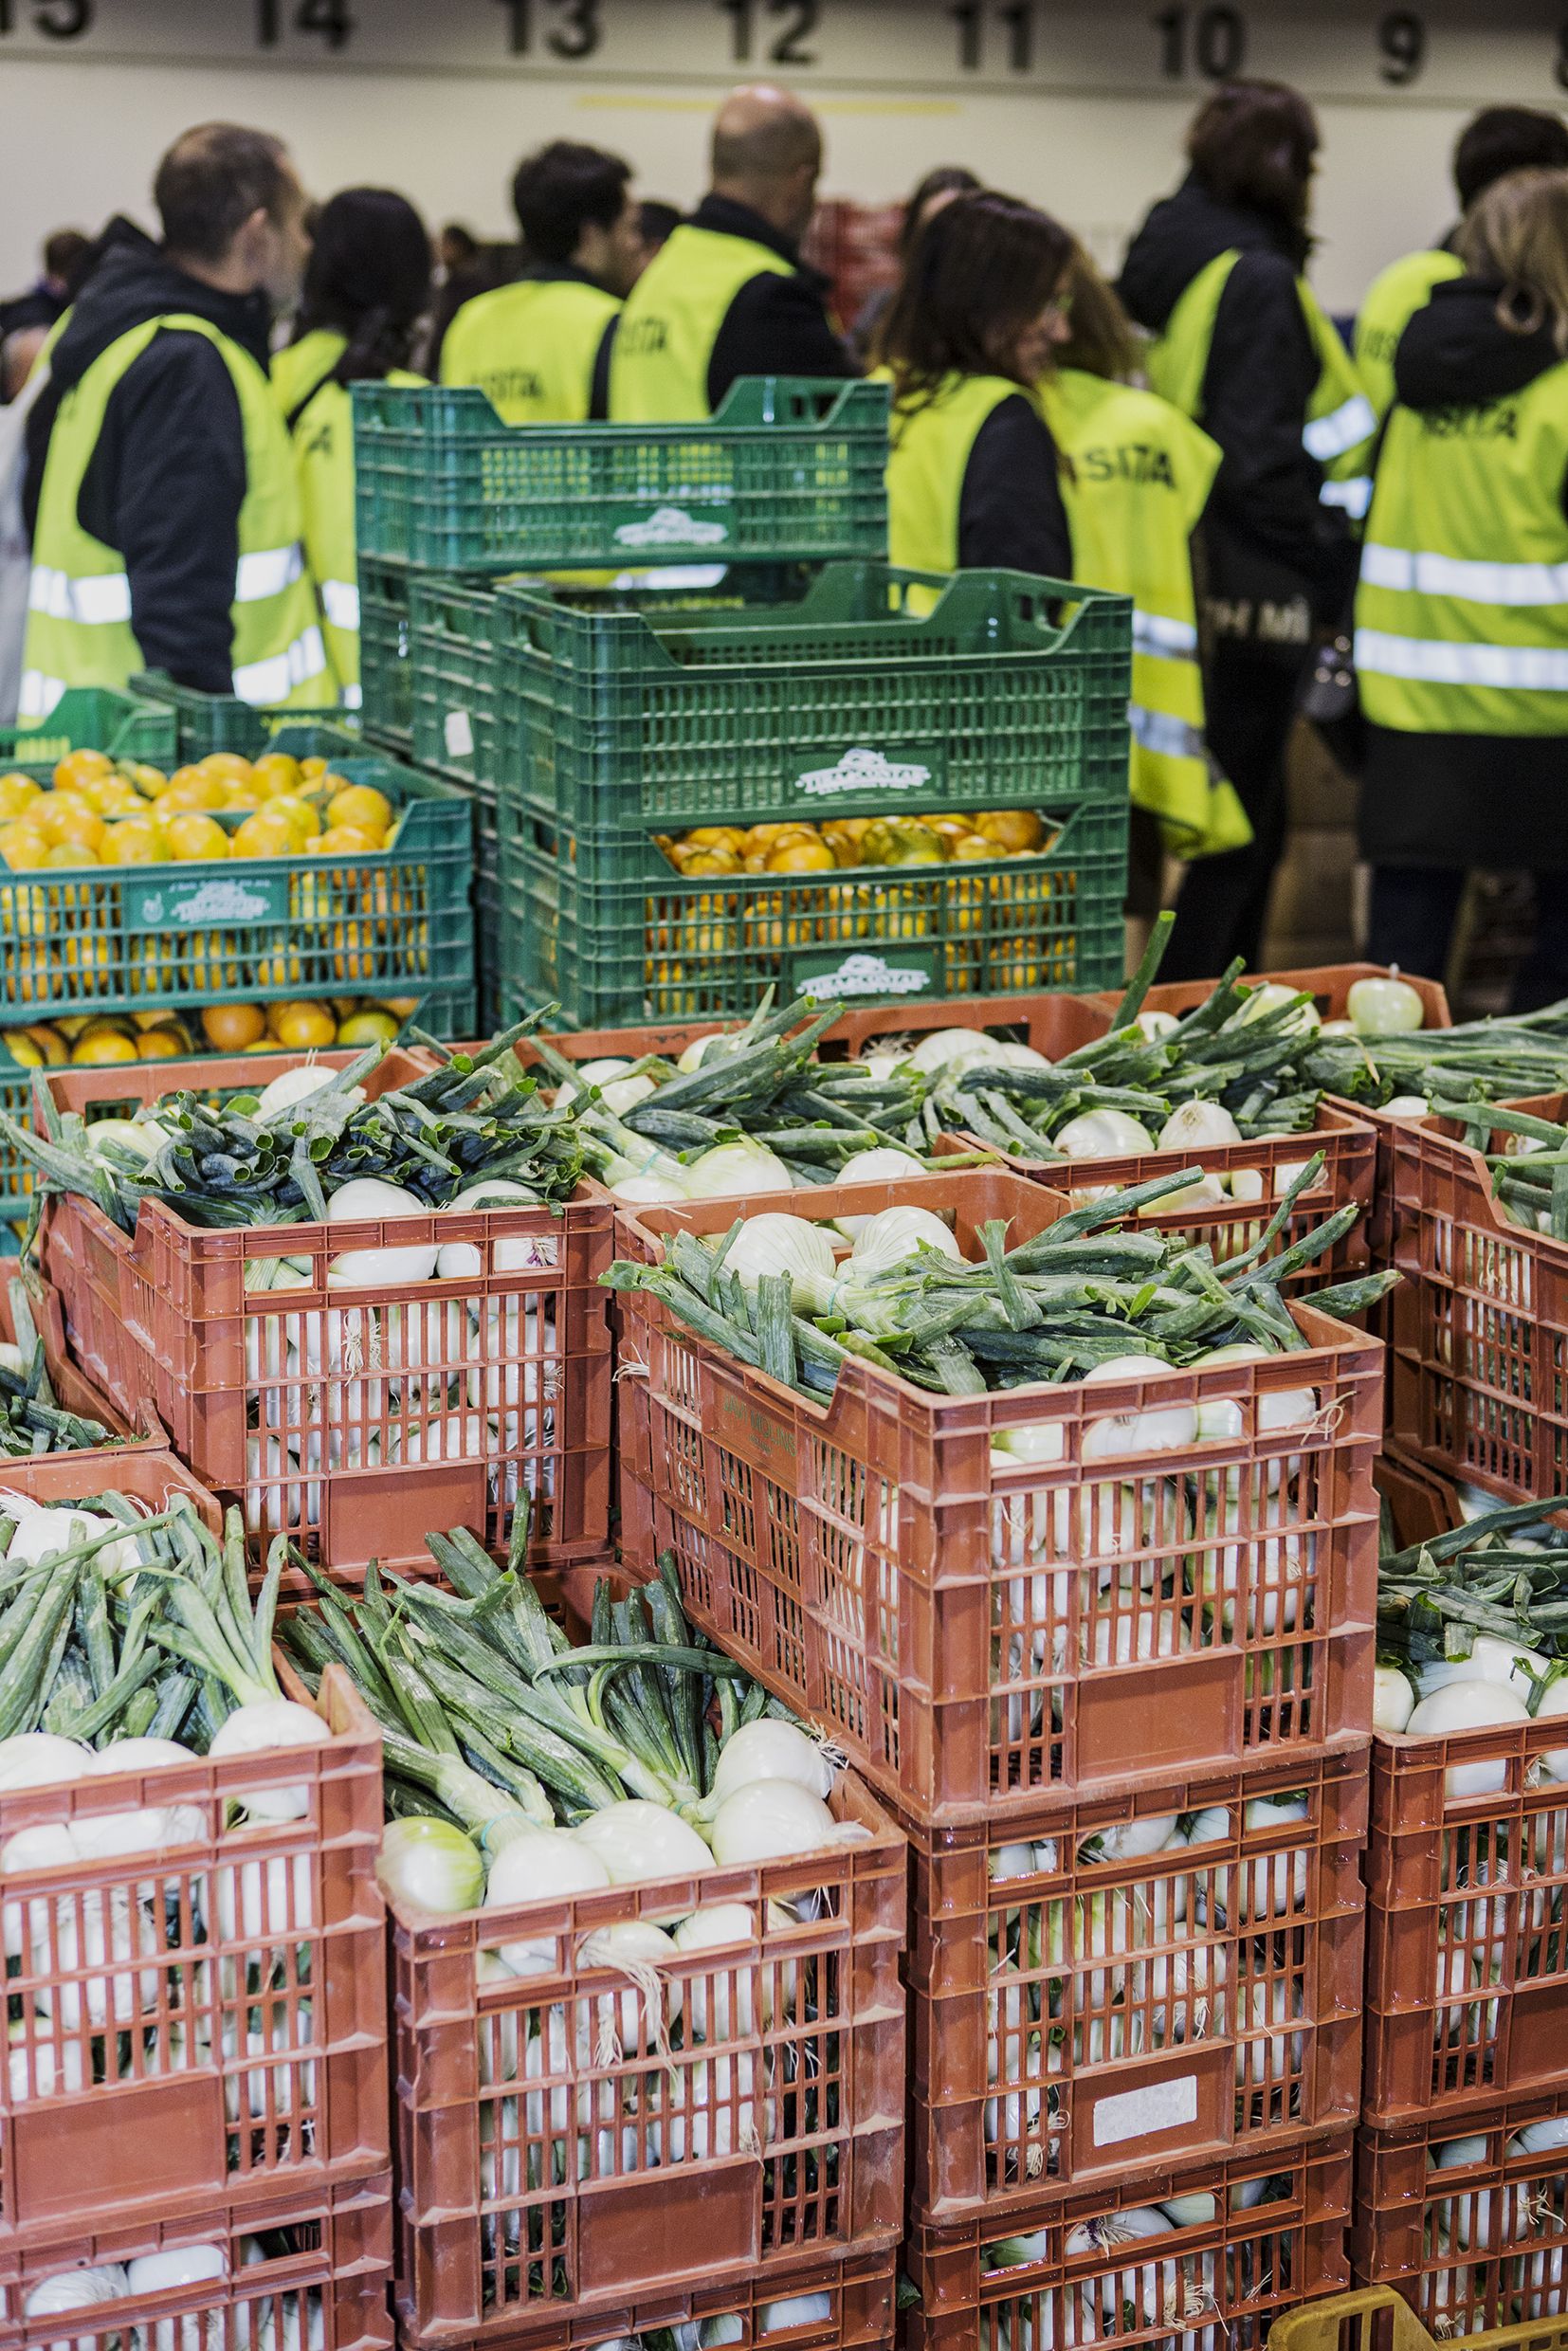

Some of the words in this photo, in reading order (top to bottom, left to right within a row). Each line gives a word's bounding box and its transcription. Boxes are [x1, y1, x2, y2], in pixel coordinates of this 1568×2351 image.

[253, 0, 355, 49] 14
[506, 0, 599, 60] 13
[719, 0, 819, 64] 12
[948, 1, 1034, 72] 11
[1157, 5, 1245, 81] 10
[1378, 12, 1424, 86] 9
